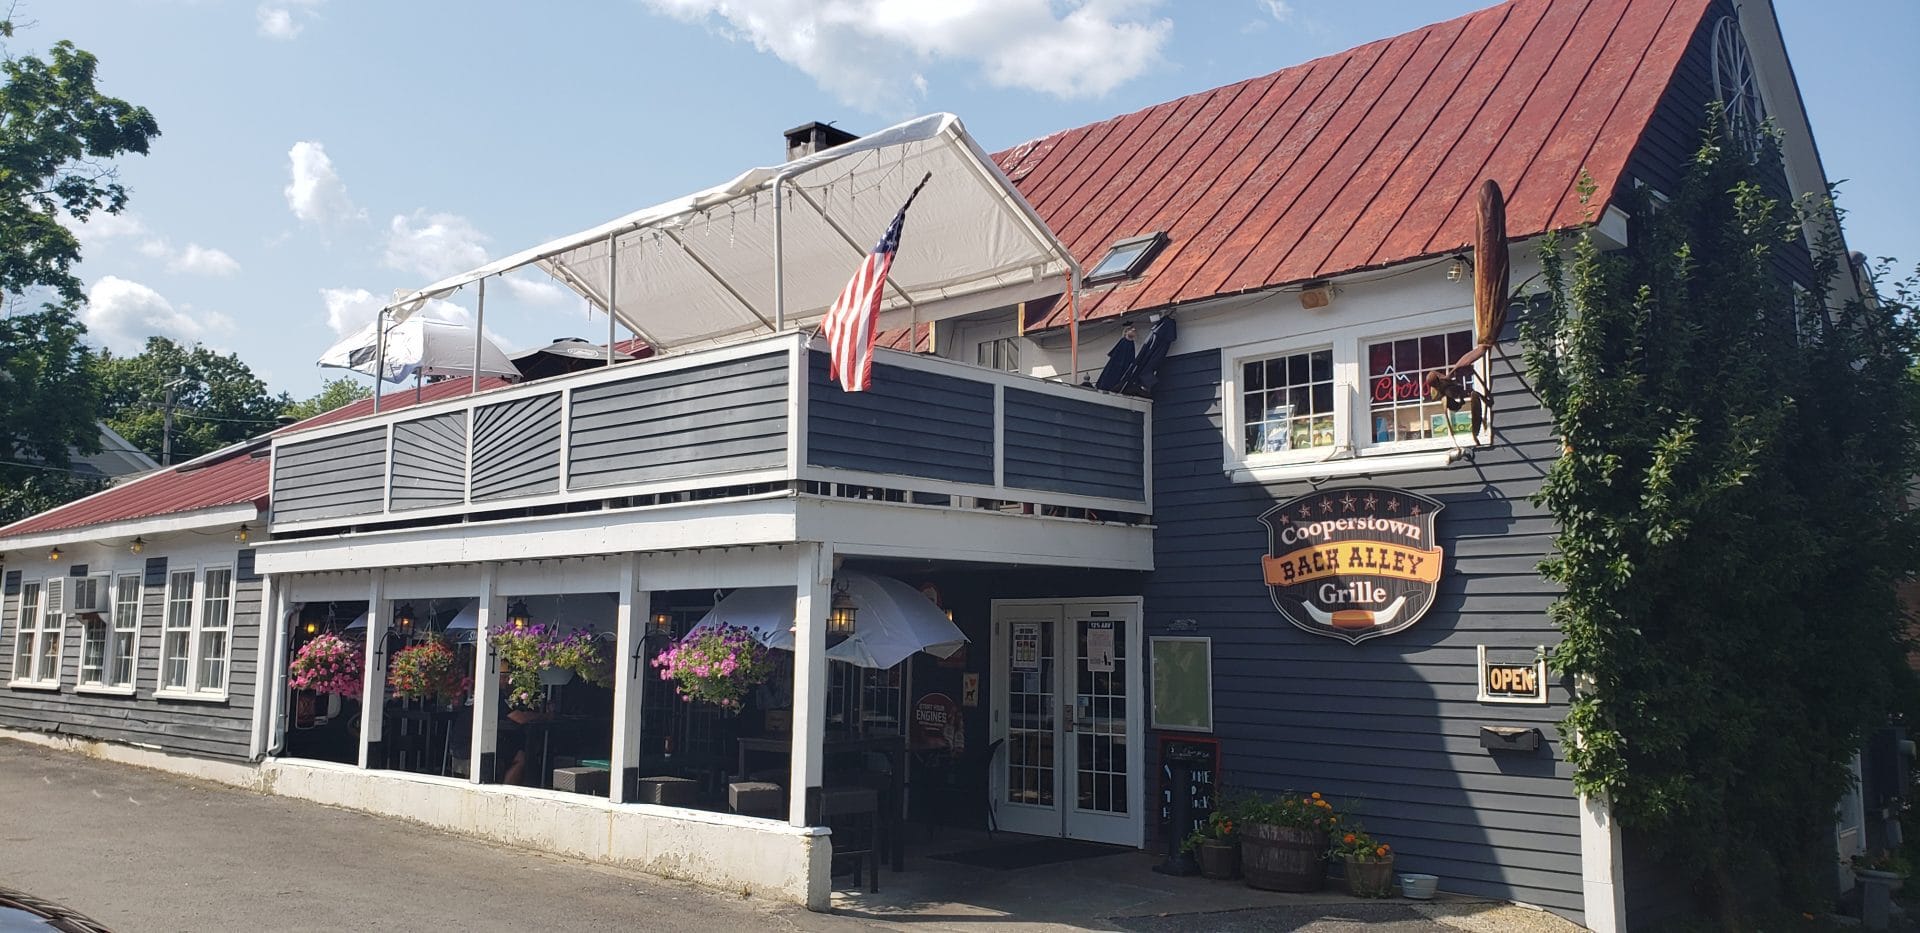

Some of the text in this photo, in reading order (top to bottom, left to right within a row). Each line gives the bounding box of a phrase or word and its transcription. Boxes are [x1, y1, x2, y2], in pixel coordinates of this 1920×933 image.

[1375, 377, 1431, 400] Coors
[1281, 515, 1421, 545] Cooperstown
[1280, 547, 1424, 581] BACK ALLEY
[1319, 581, 1387, 604] Grille
[1490, 668, 1534, 691] OPEN
[916, 710, 947, 723] ENGINES
